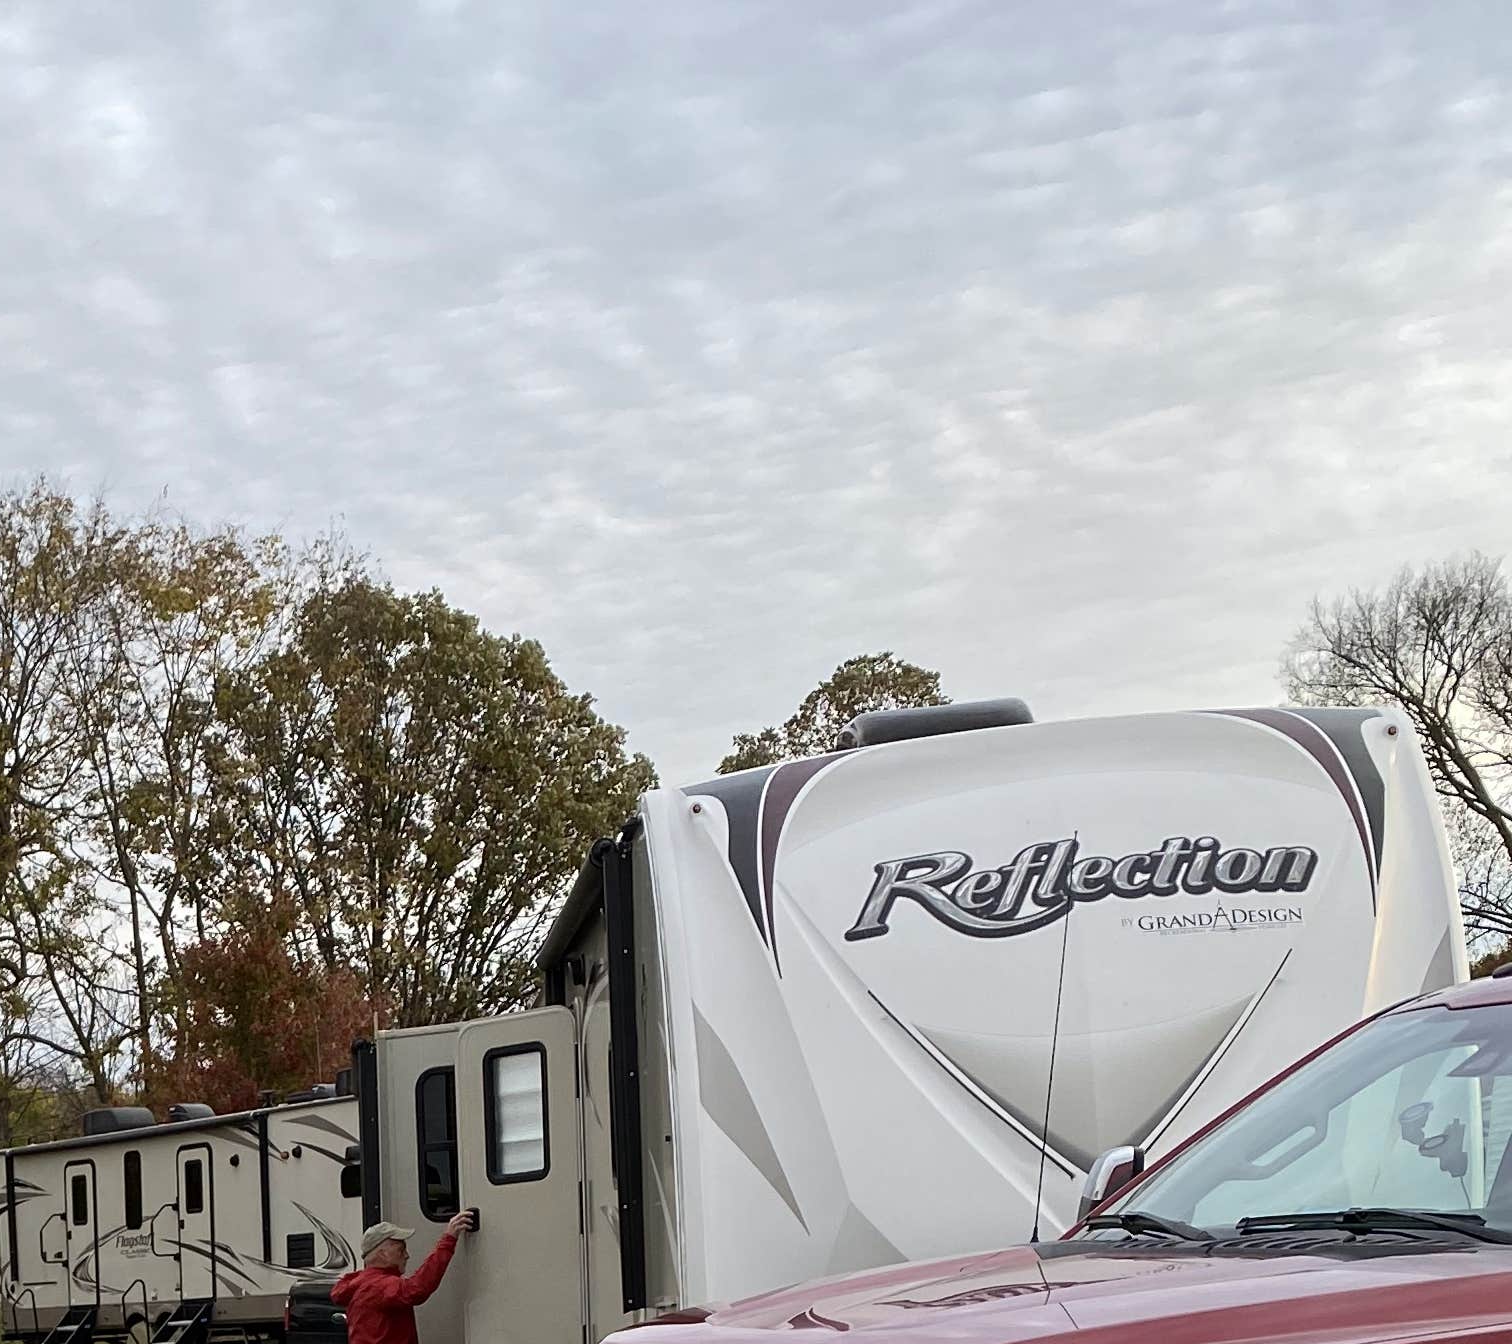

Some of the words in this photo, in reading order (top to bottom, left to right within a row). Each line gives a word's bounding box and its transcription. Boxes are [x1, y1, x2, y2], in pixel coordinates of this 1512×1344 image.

[844, 836, 1319, 942] Reflection
[1138, 912, 1213, 931] GRAND
[1232, 907, 1303, 925] DESIGN
[116, 1233, 155, 1248] Flagstaf
